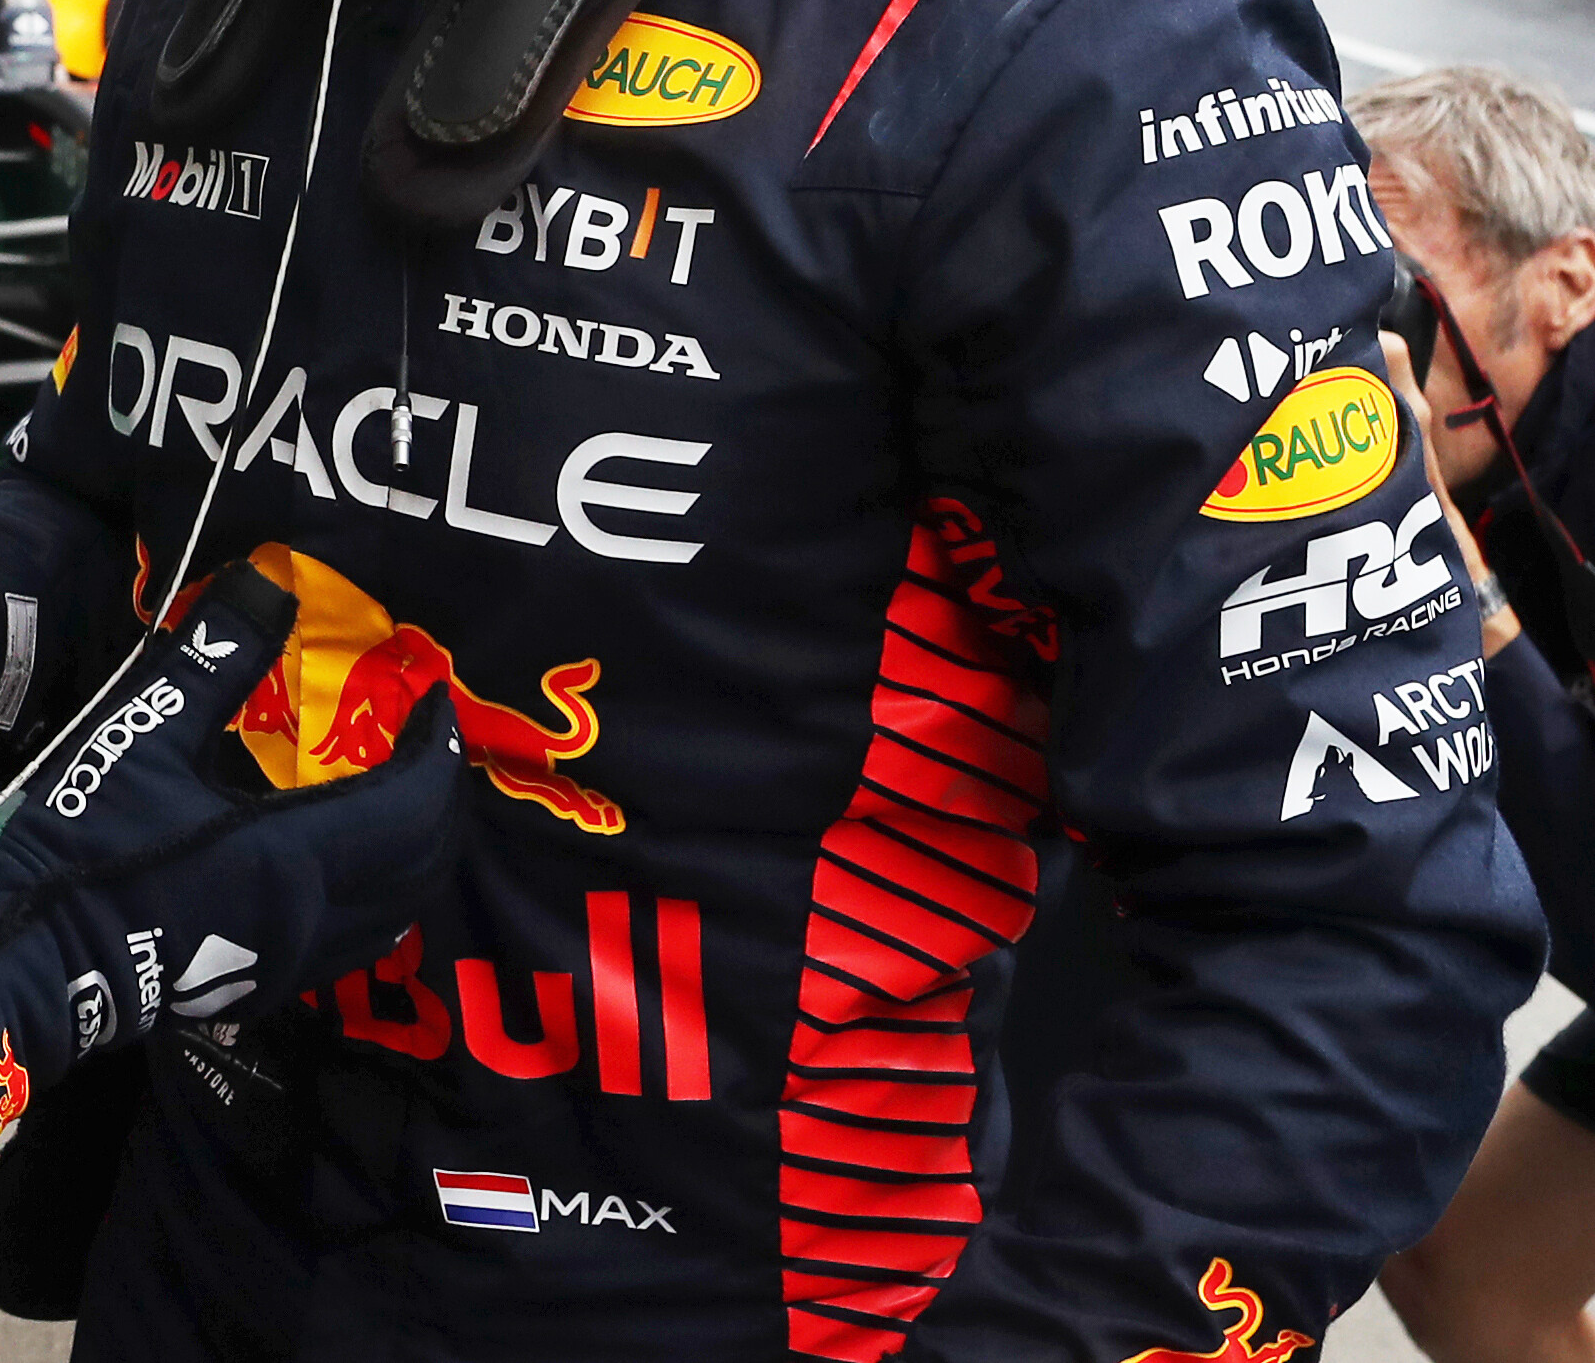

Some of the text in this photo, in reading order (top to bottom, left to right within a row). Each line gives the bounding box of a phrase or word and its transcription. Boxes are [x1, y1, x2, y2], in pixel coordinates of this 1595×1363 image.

[123, 141, 226, 211] Mobil
[474, 183, 715, 285] BYBIT
[1158, 164, 1394, 300] ROKT
[438, 292, 721, 381] HONDA
[107, 322, 714, 565] ORACLE
[1251, 392, 1387, 487] RAUCH
[1220, 491, 1452, 658] HRC
[1363, 586, 1462, 641] RACING
[49, 676, 185, 818] sparco
[540, 1187, 678, 1235] MAX
